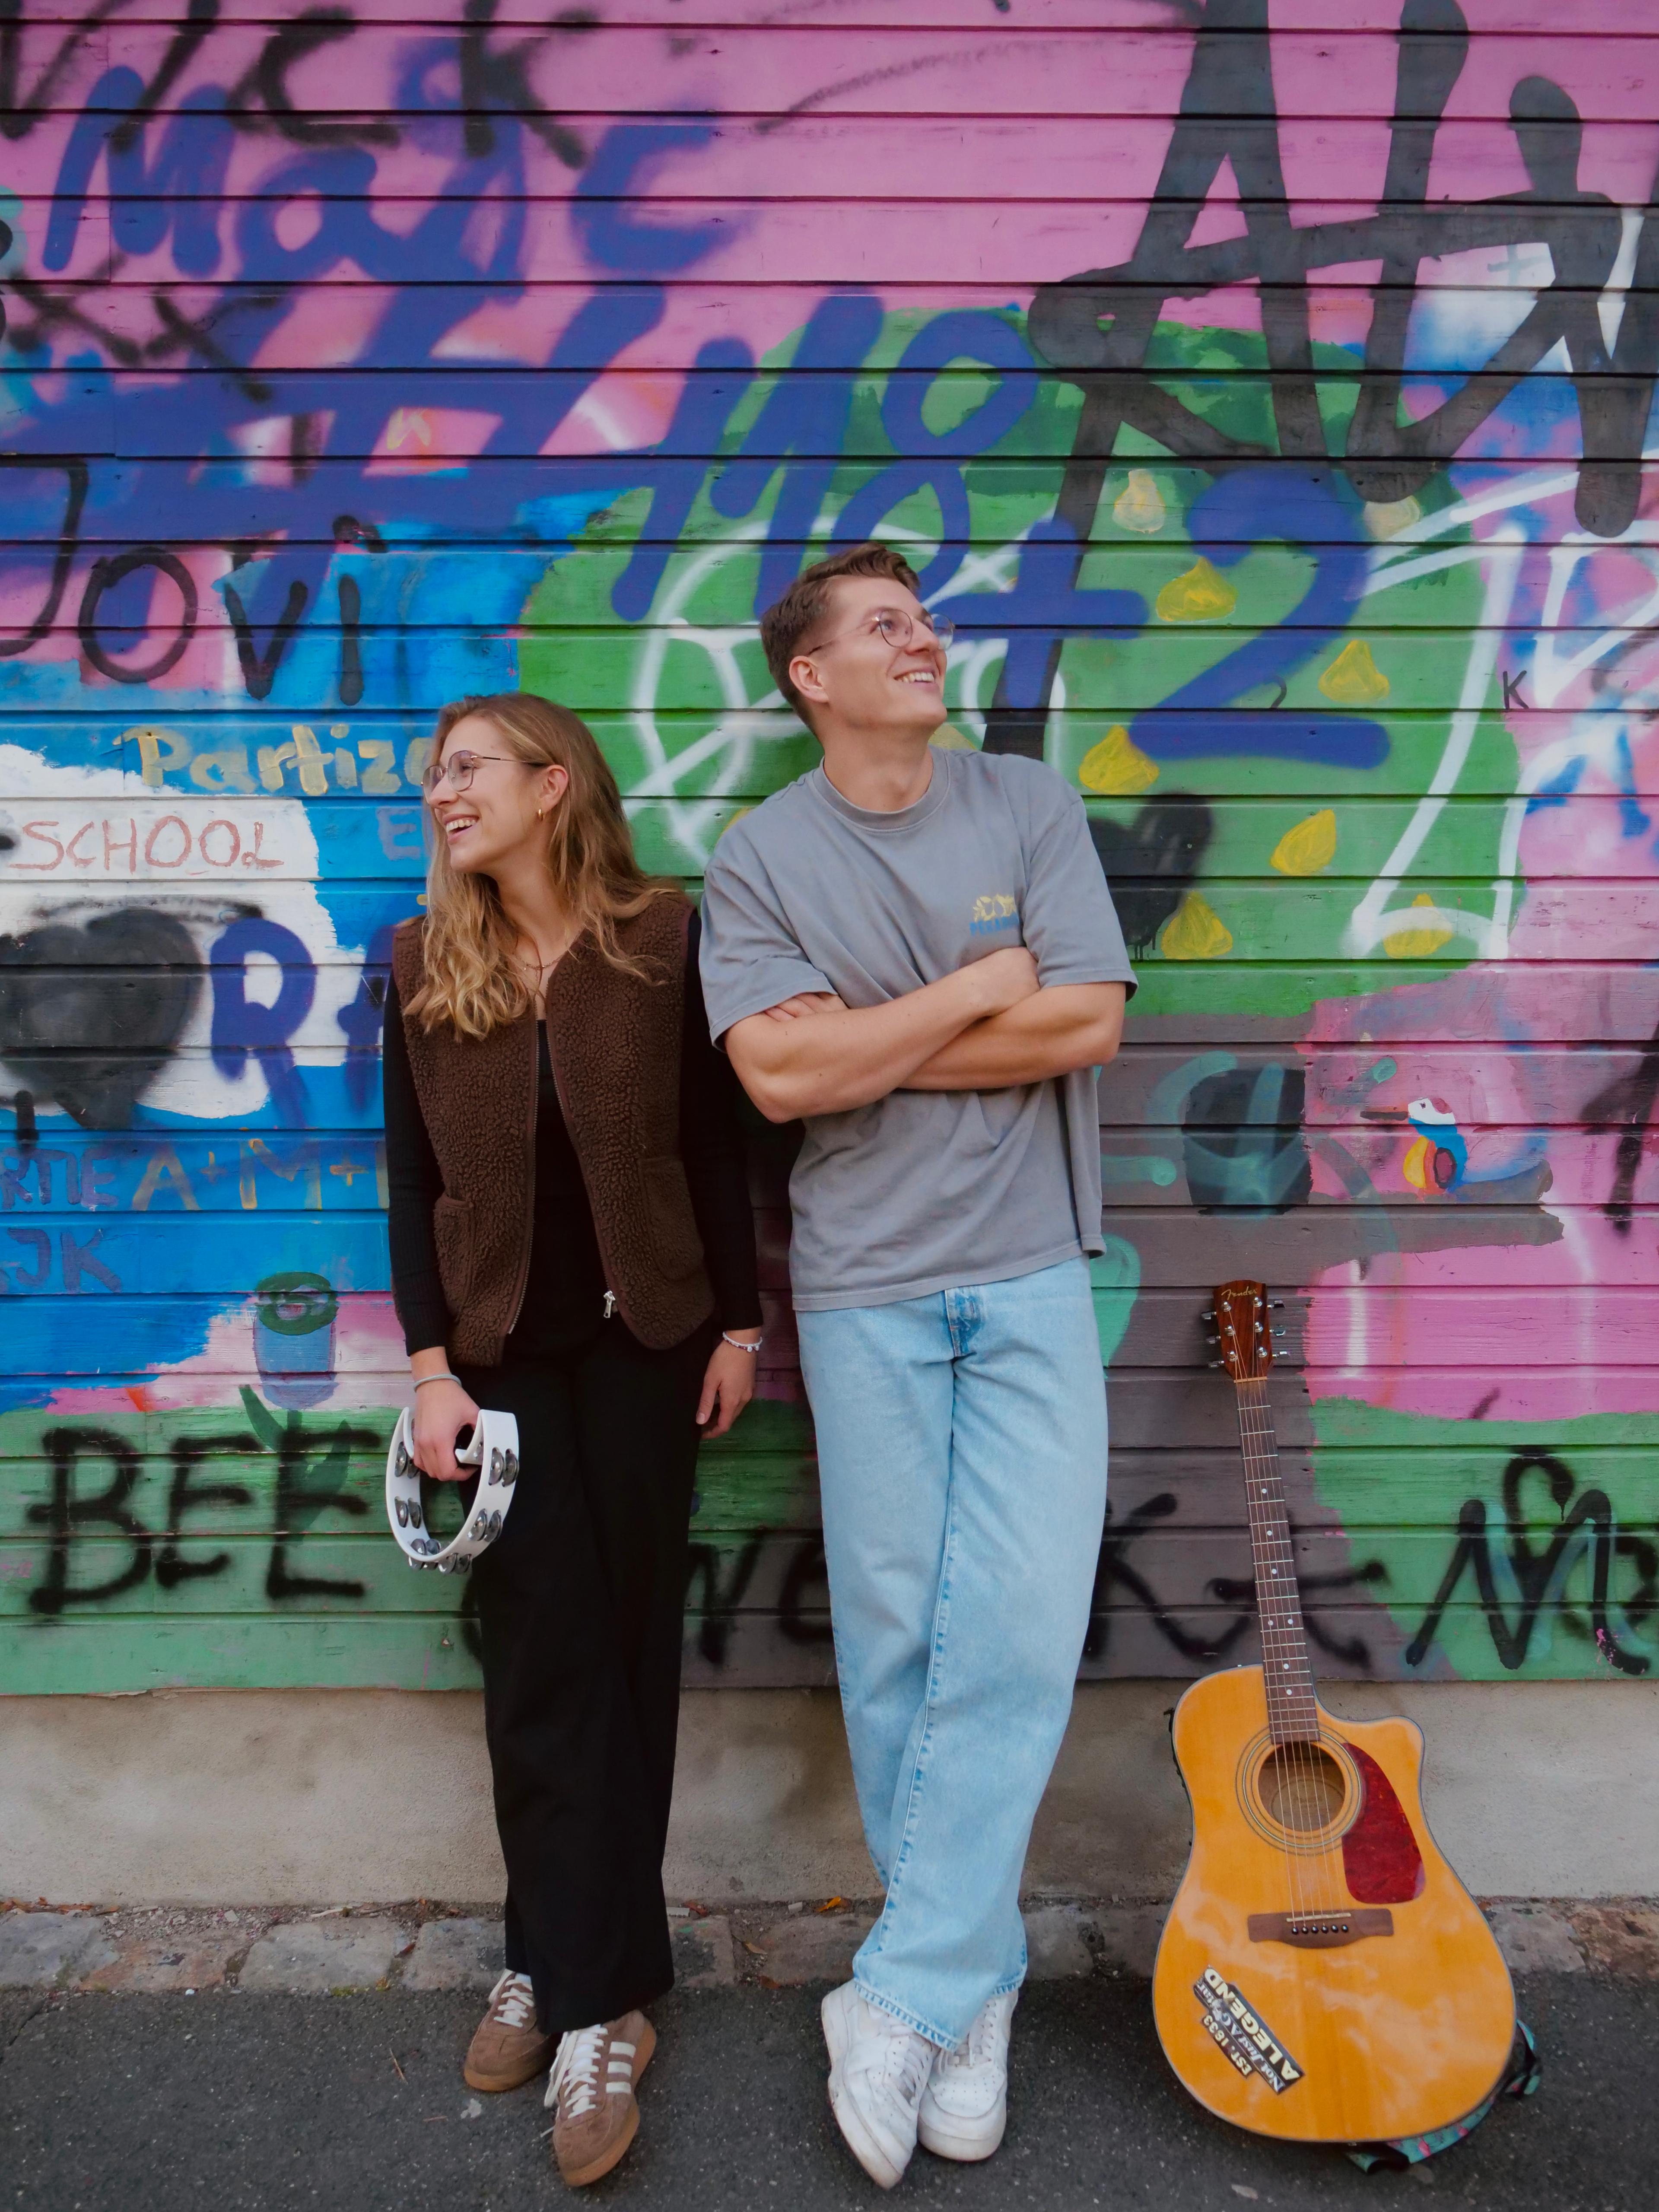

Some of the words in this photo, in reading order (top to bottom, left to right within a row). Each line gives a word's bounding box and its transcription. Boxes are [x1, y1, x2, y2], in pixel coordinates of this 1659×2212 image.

[1503, 670, 1529, 710] K
[12, 815, 284, 874] SCHOOL
[1221, 1286, 1258, 1300] Fender
[1204, 1968, 1283, 2065] LEGEND
[1204, 2015, 1229, 2047] 1833
[1230, 2046, 1252, 2075] EST.
[1238, 2036, 1264, 2061] Just
[1260, 2063, 1285, 2092] Not
[1281, 2058, 1300, 2080] A
